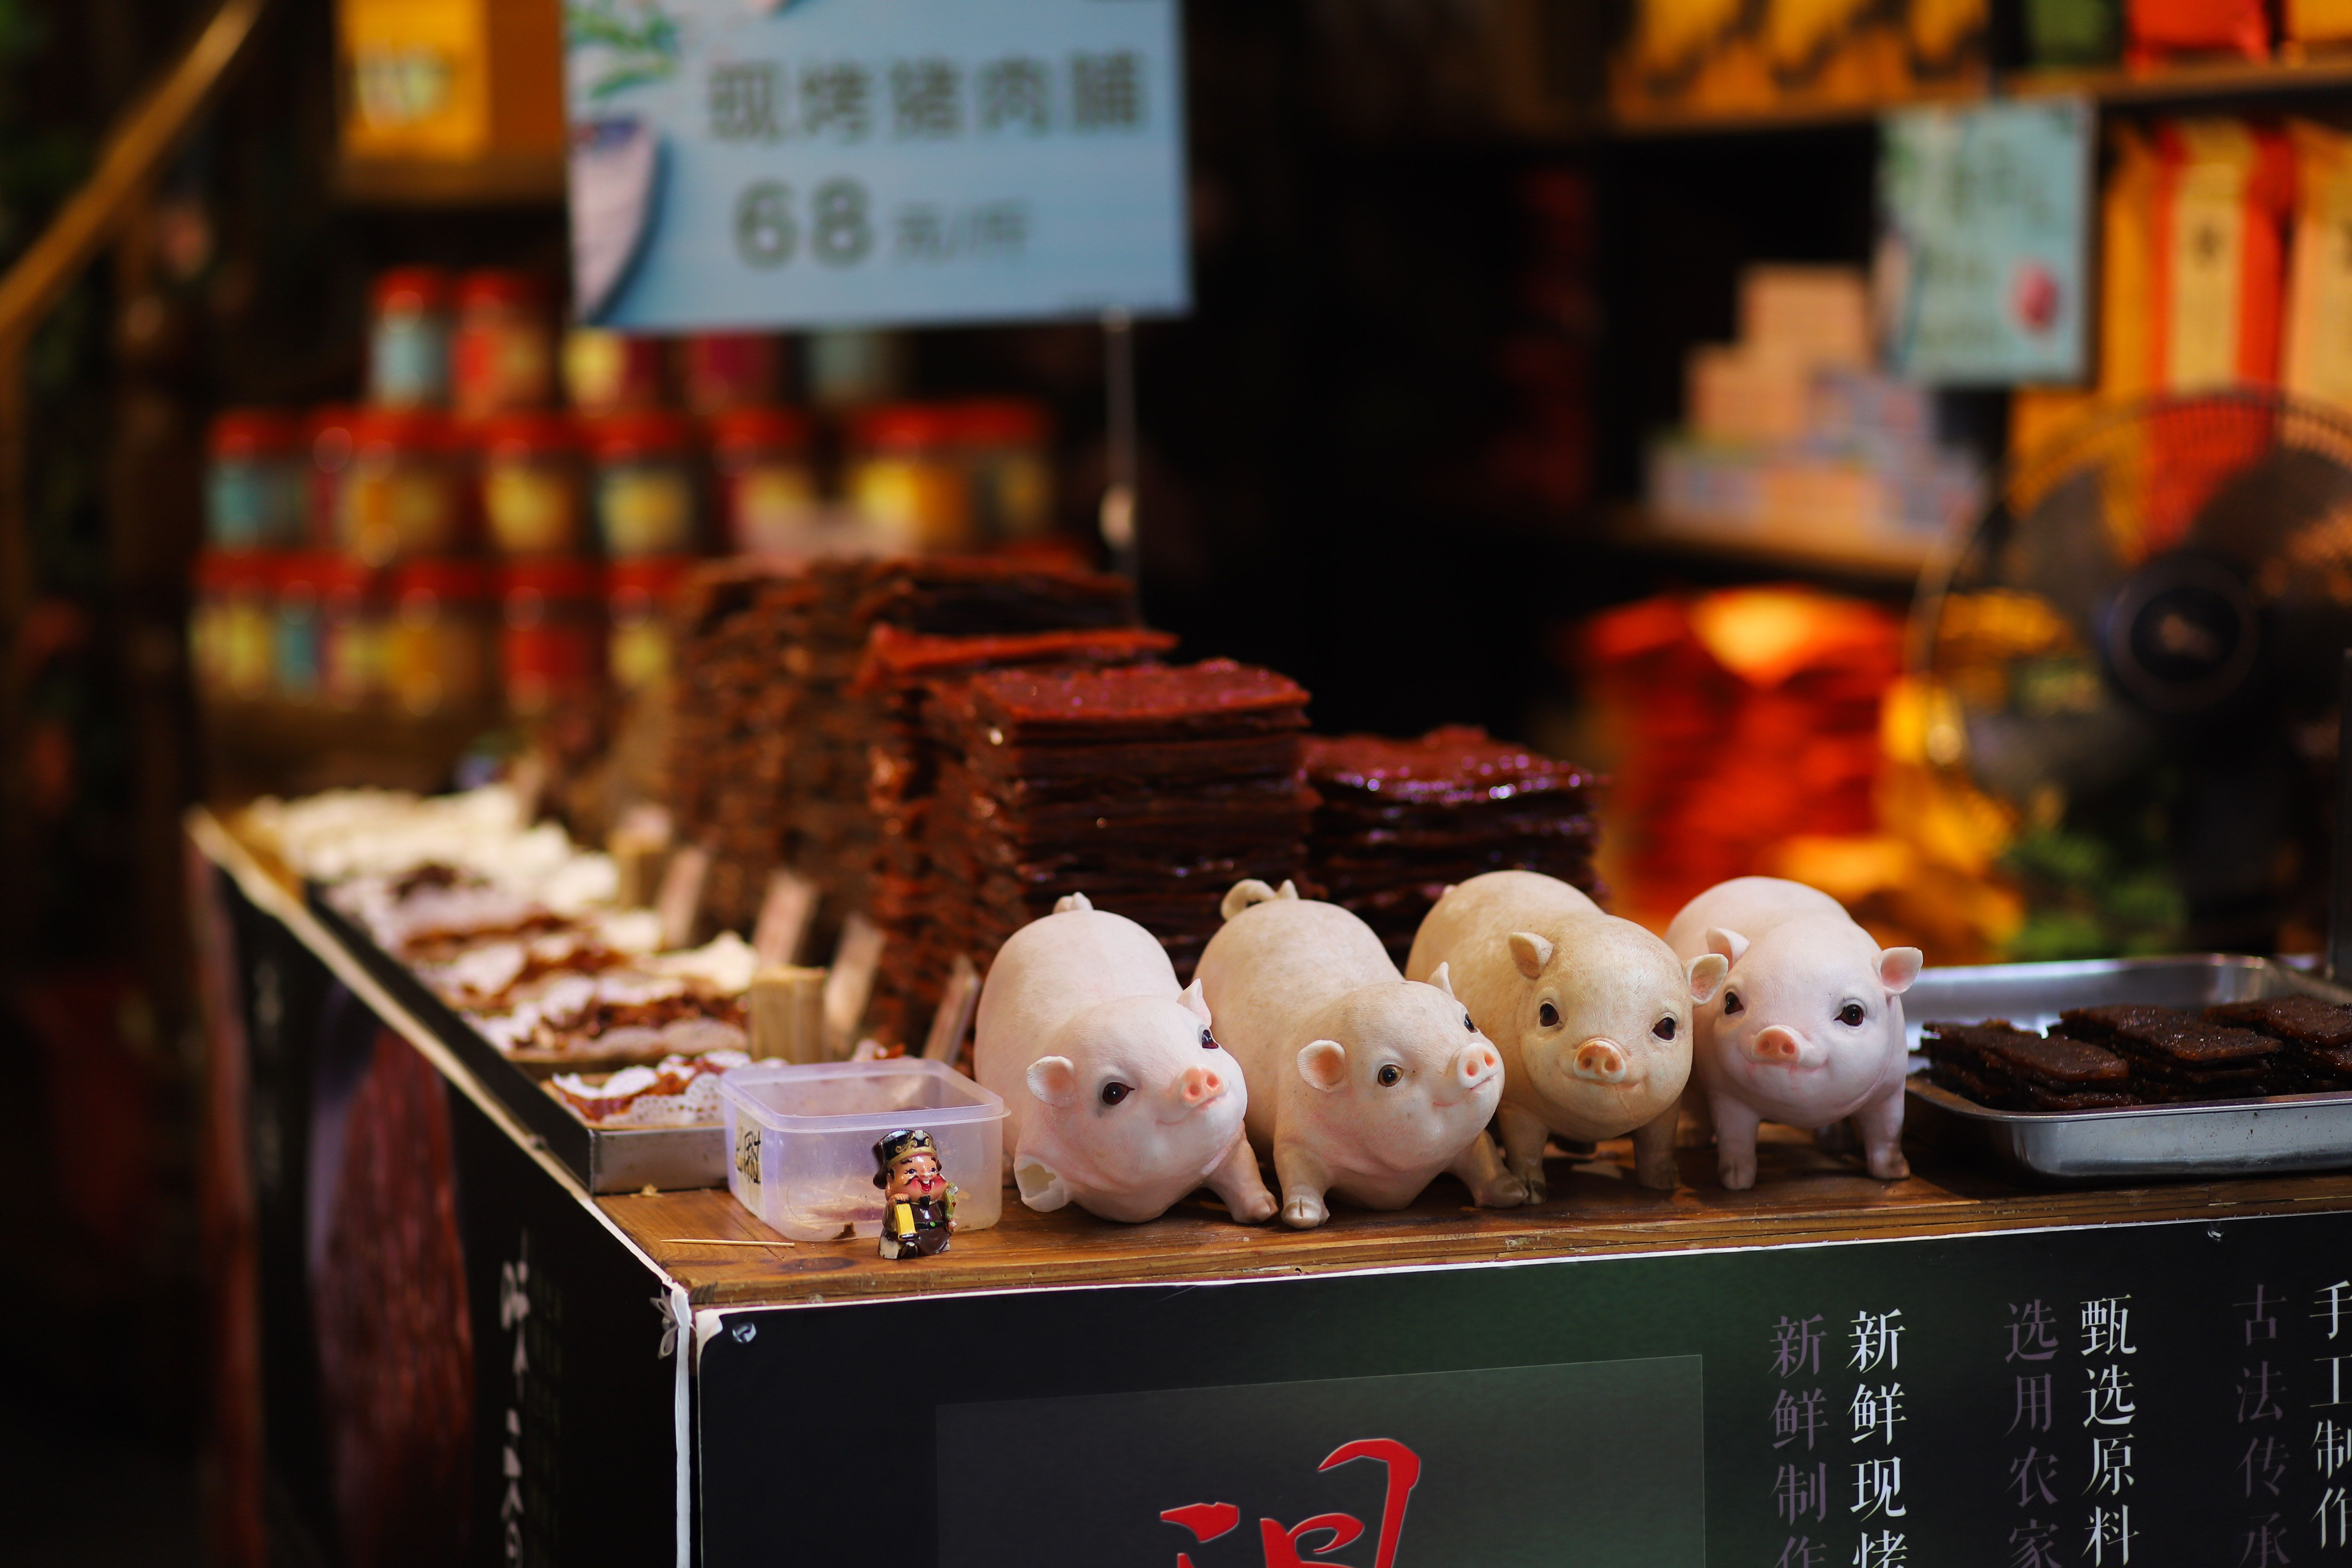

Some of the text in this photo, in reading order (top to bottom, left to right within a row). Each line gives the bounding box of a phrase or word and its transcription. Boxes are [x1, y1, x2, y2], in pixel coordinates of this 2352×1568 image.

[735, 178, 871, 267] 68
[1846, 1308, 1907, 1568] 新鲜现烤
[2003, 1299, 2060, 1568] 选用农家
[2081, 1294, 2139, 1567] 甄选原料
[2232, 1284, 2291, 1568] 古法传承
